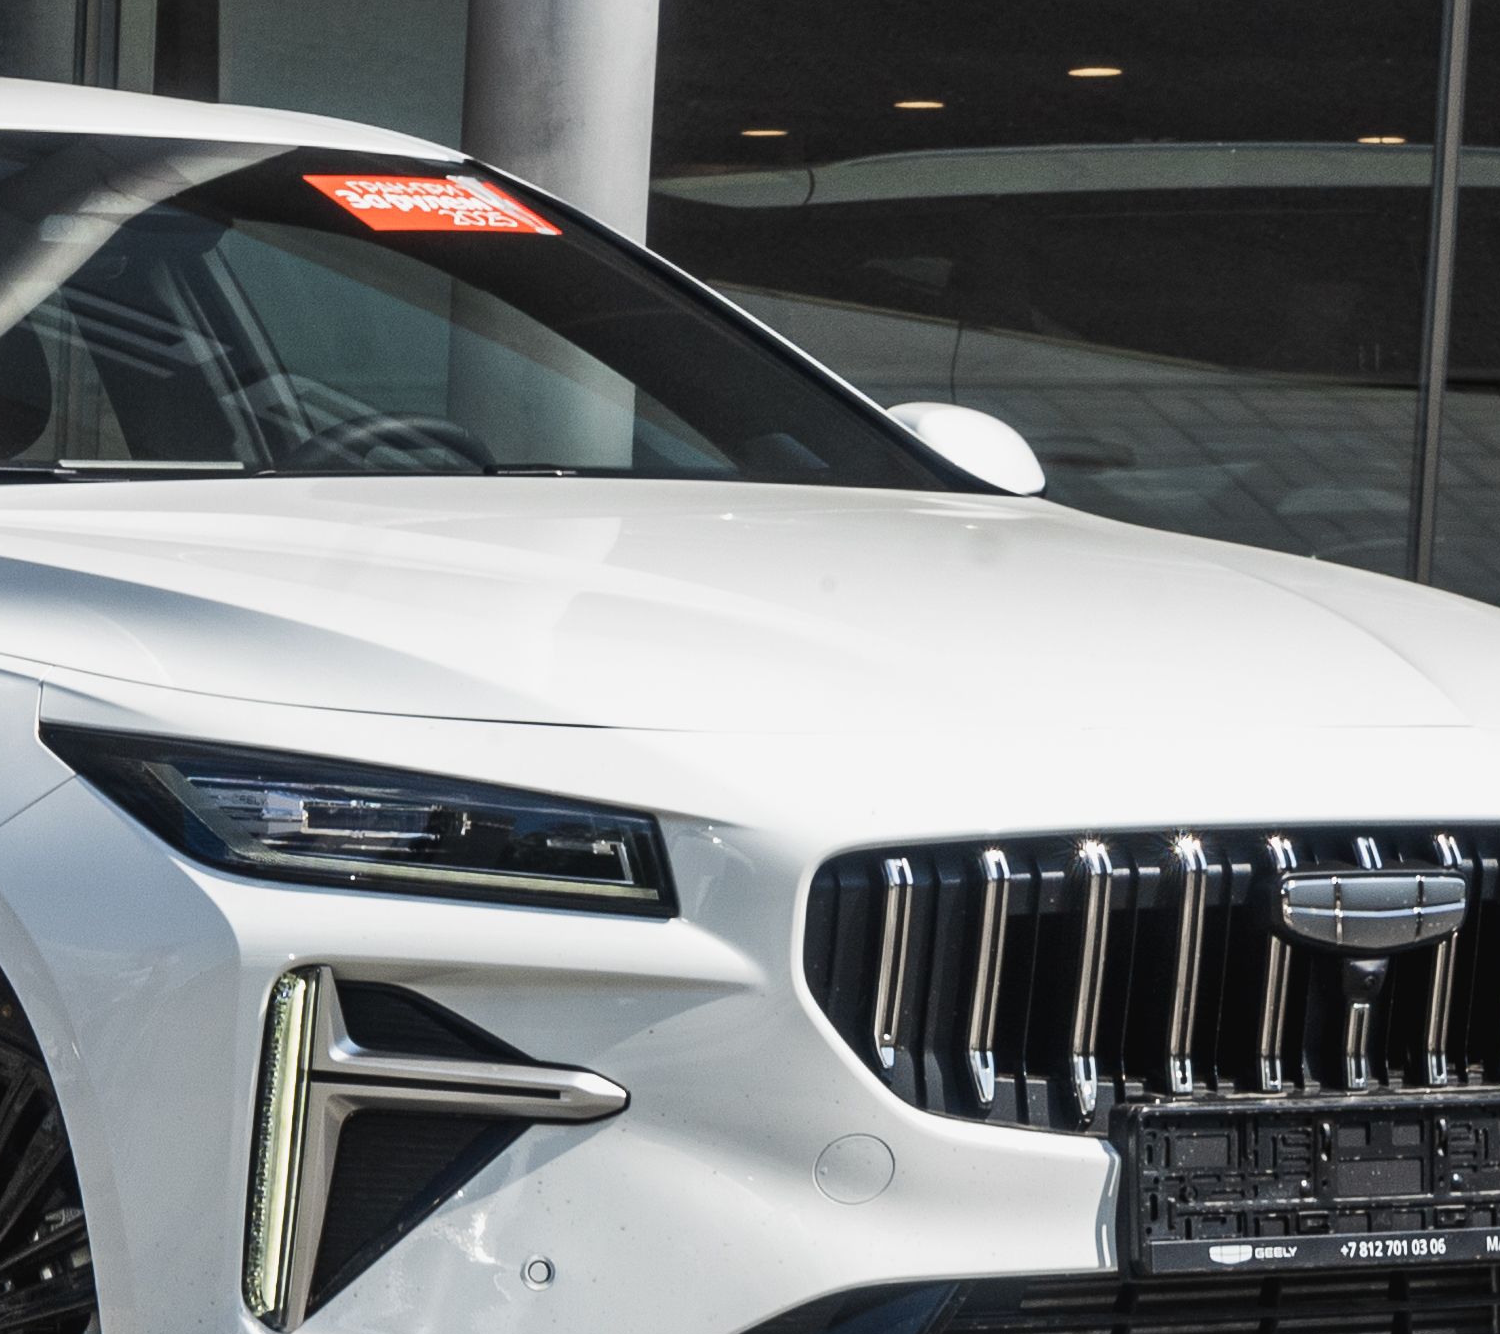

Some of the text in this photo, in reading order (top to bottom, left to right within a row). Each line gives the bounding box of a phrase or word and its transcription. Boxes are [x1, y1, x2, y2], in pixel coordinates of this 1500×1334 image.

[1254, 1246, 1298, 1260] GEELY
[1340, 1237, 1447, 1259] +7 812 701 03 06
